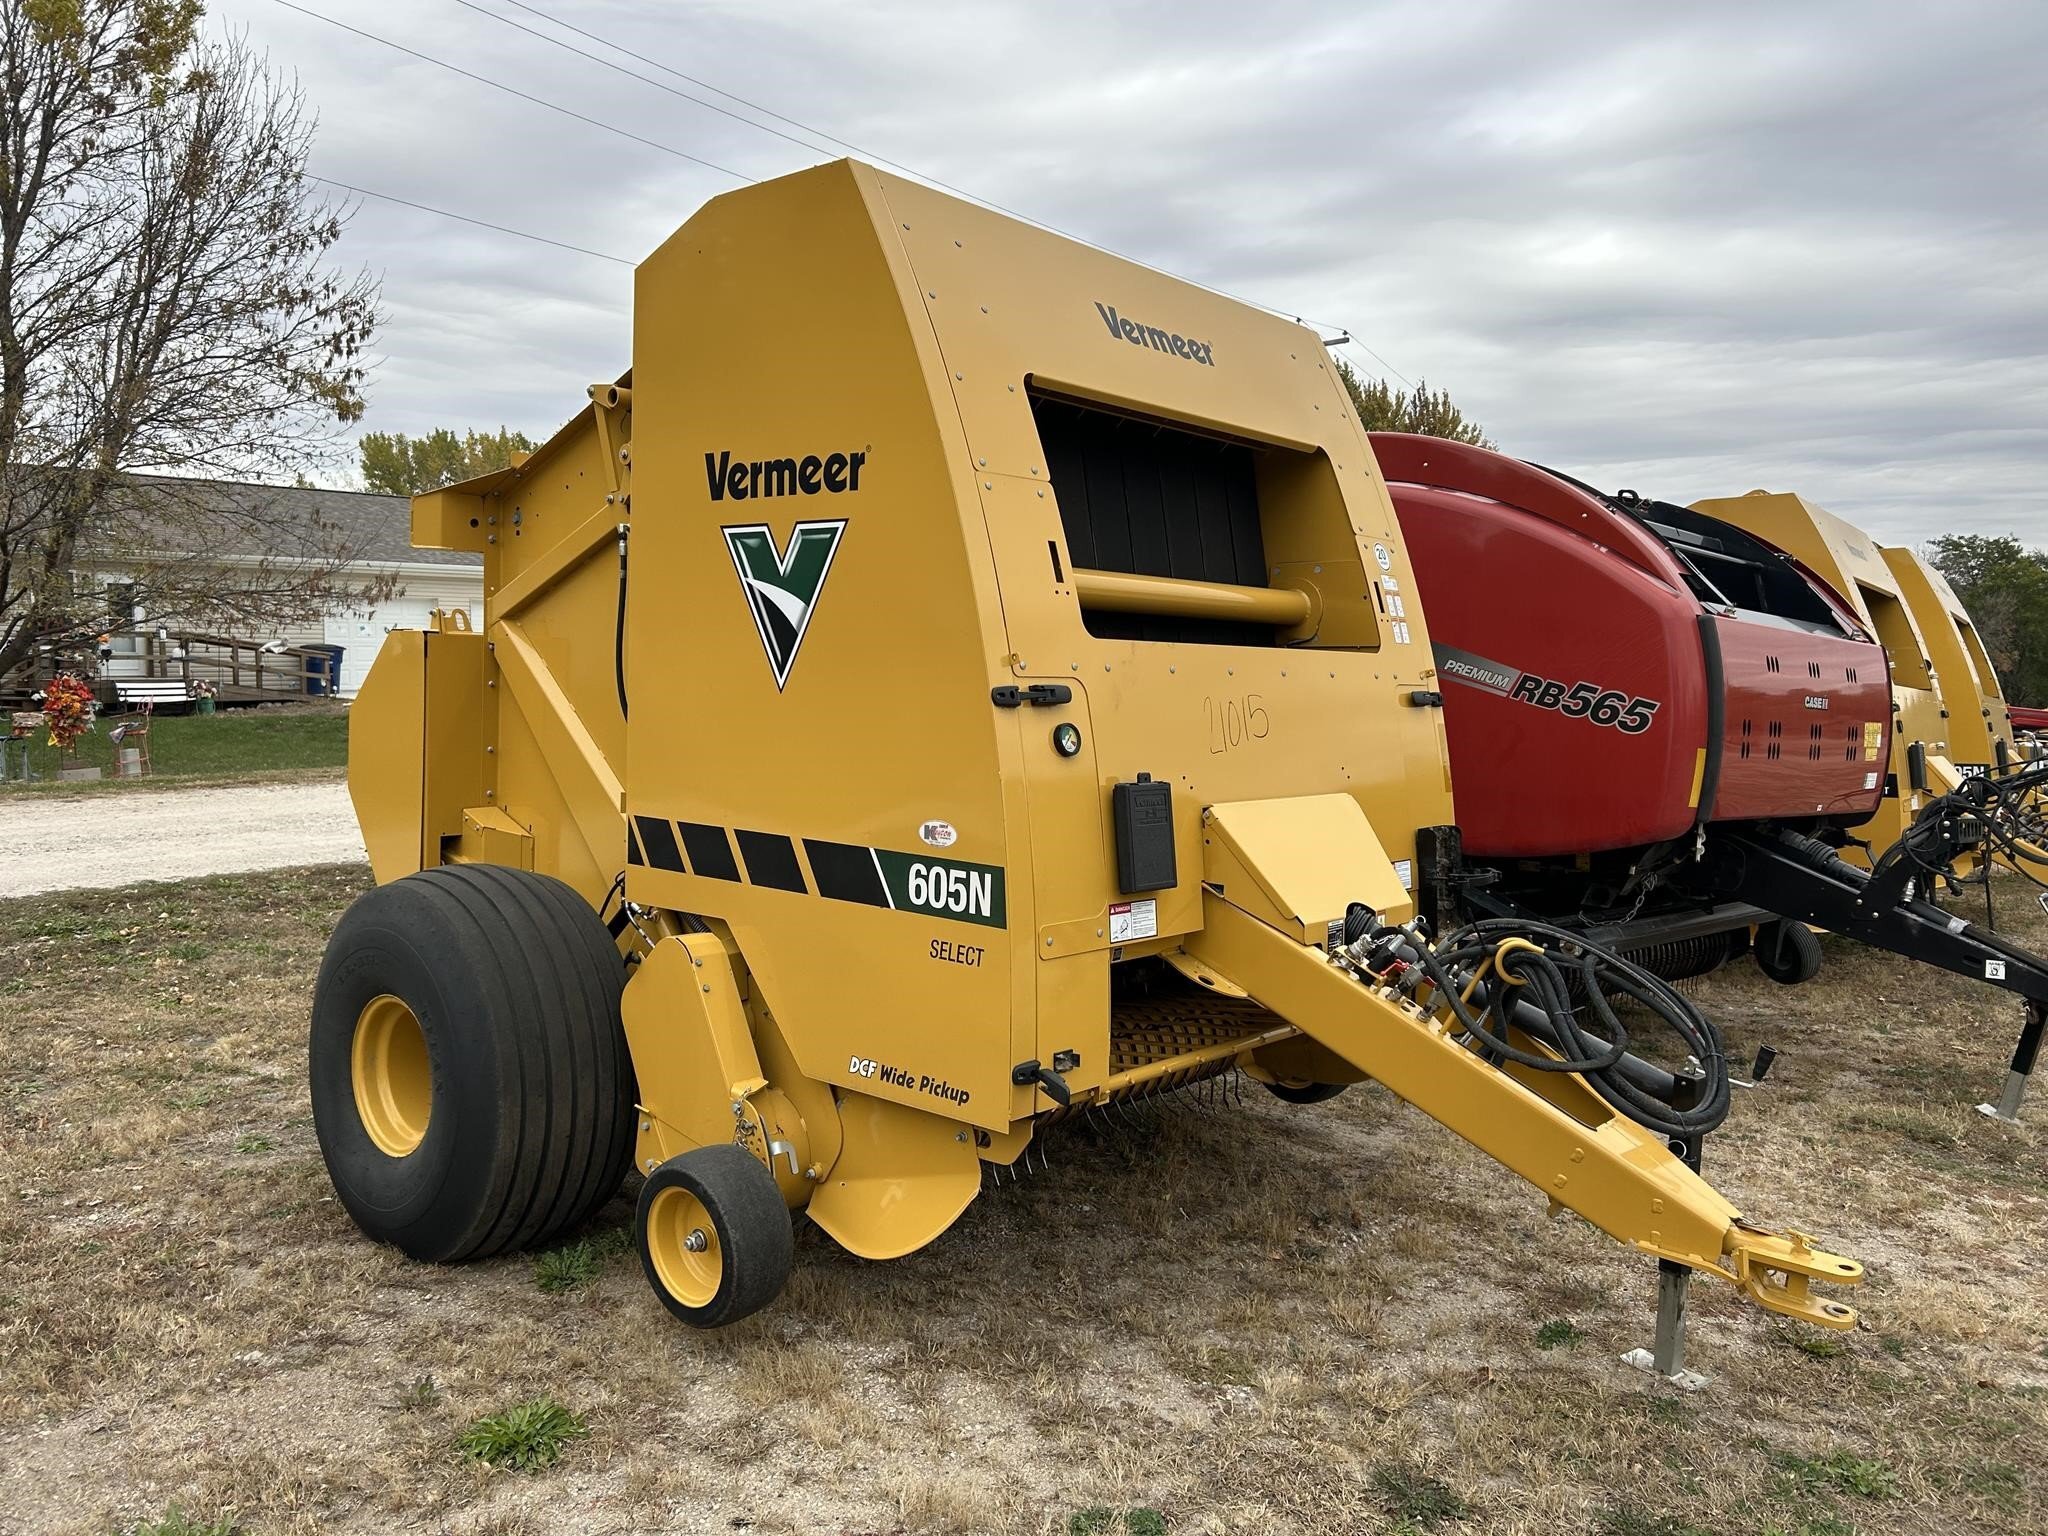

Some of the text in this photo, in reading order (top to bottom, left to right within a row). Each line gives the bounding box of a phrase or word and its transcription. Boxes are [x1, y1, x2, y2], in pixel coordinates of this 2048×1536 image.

[1094, 301, 1215, 367] Vermeer
[705, 450, 867, 501] Vermeer
[1444, 659, 1661, 735] PREMIUM RB565
[1804, 696, 1822, 709] CASE
[1203, 694, 1270, 755] 21015
[908, 862, 992, 918] 605N
[929, 938, 985, 968] SELECT
[848, 1055, 971, 1107] DCF Wide Pickup
